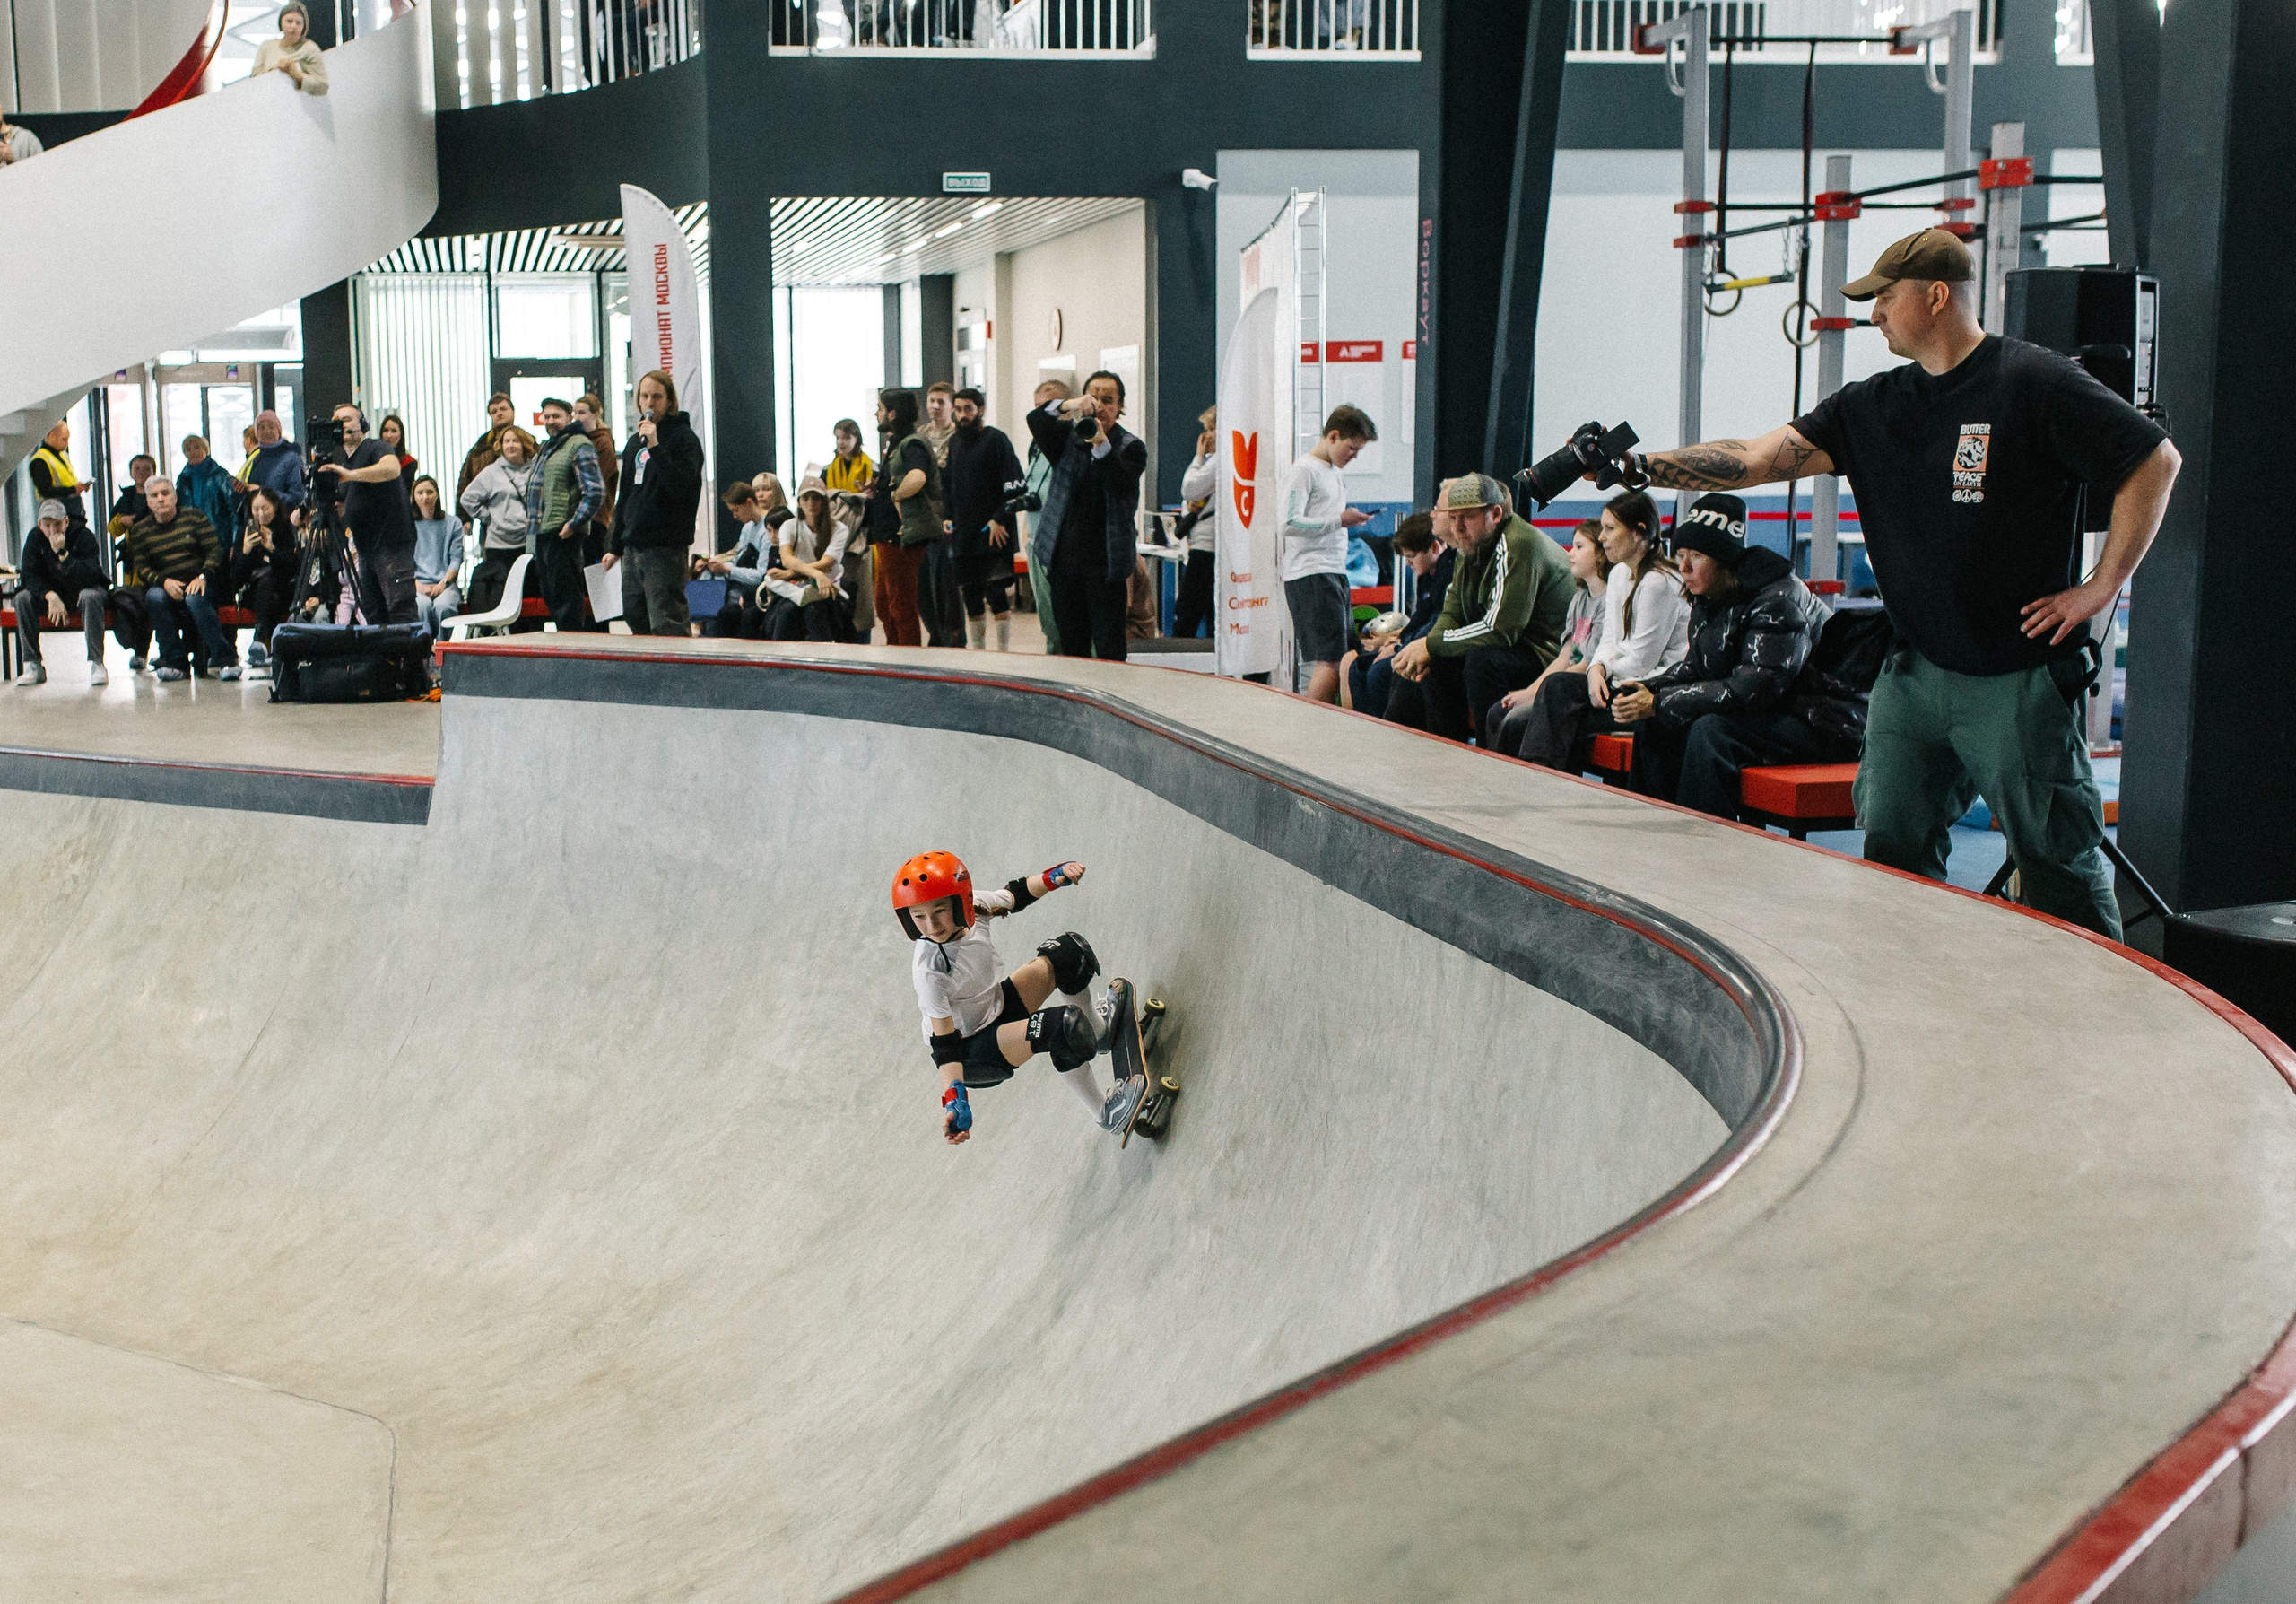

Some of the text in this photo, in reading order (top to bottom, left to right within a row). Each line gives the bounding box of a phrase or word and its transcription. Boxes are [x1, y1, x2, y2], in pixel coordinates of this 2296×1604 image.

[654, 243, 673, 379] МПИОНАТ МОСКВЫ
[1960, 423, 1991, 435] BUTTER
[1952, 471, 1987, 483] PEACE
[1029, 1013, 1039, 1036] 187
